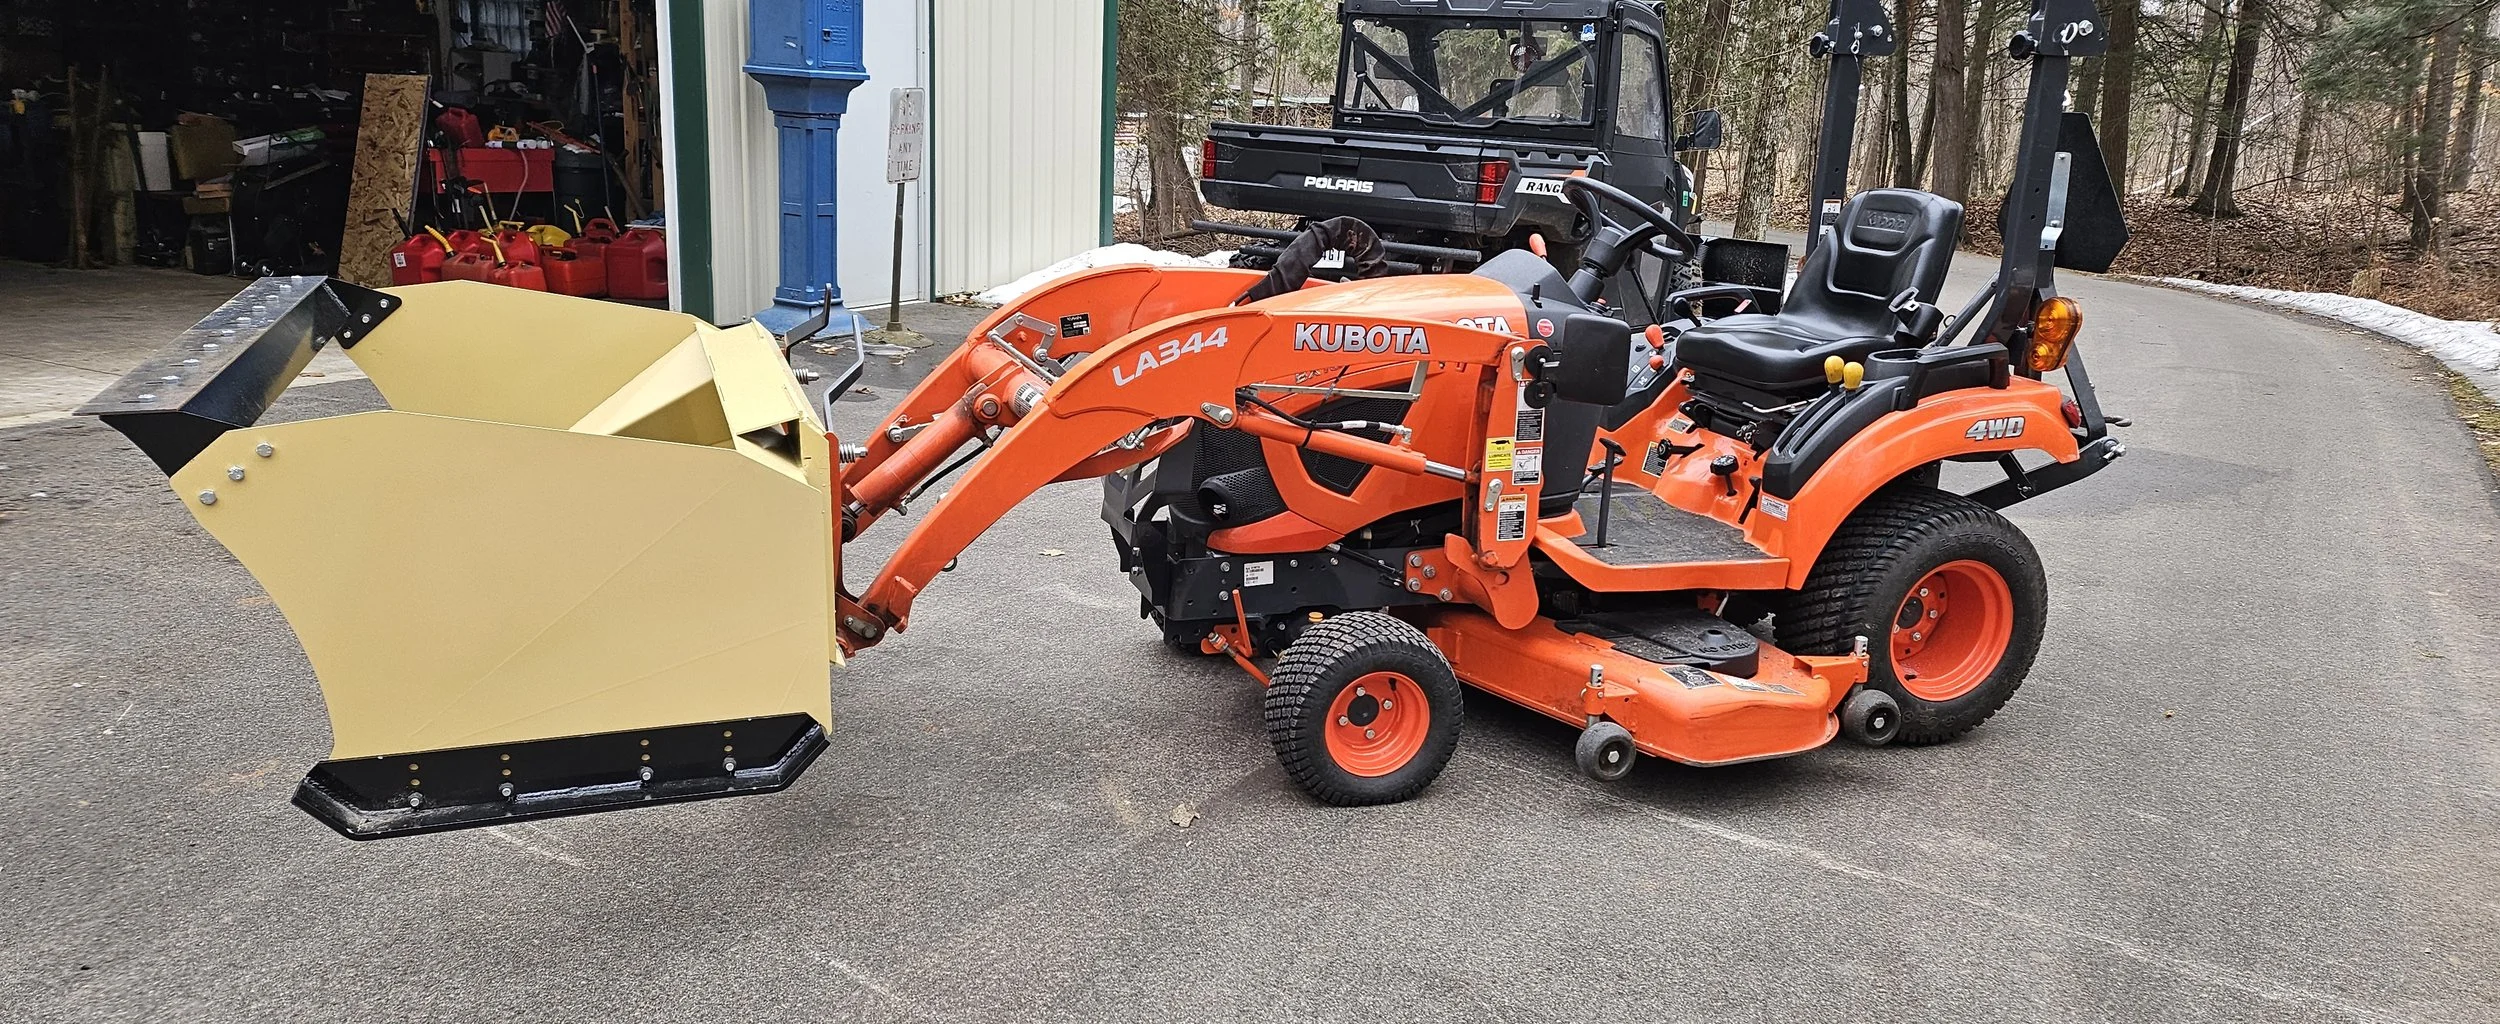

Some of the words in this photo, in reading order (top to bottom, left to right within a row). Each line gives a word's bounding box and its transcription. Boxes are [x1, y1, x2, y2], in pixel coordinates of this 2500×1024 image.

[898, 142, 912, 154] ANY
[896, 159, 913, 172] TIME
[1304, 176, 1374, 193] POLARIS
[1526, 181, 1564, 194] RANG
[1294, 323, 1430, 355] KUBOTA
[1112, 326, 1229, 388] LA344
[1965, 416, 2026, 441] 4WD
